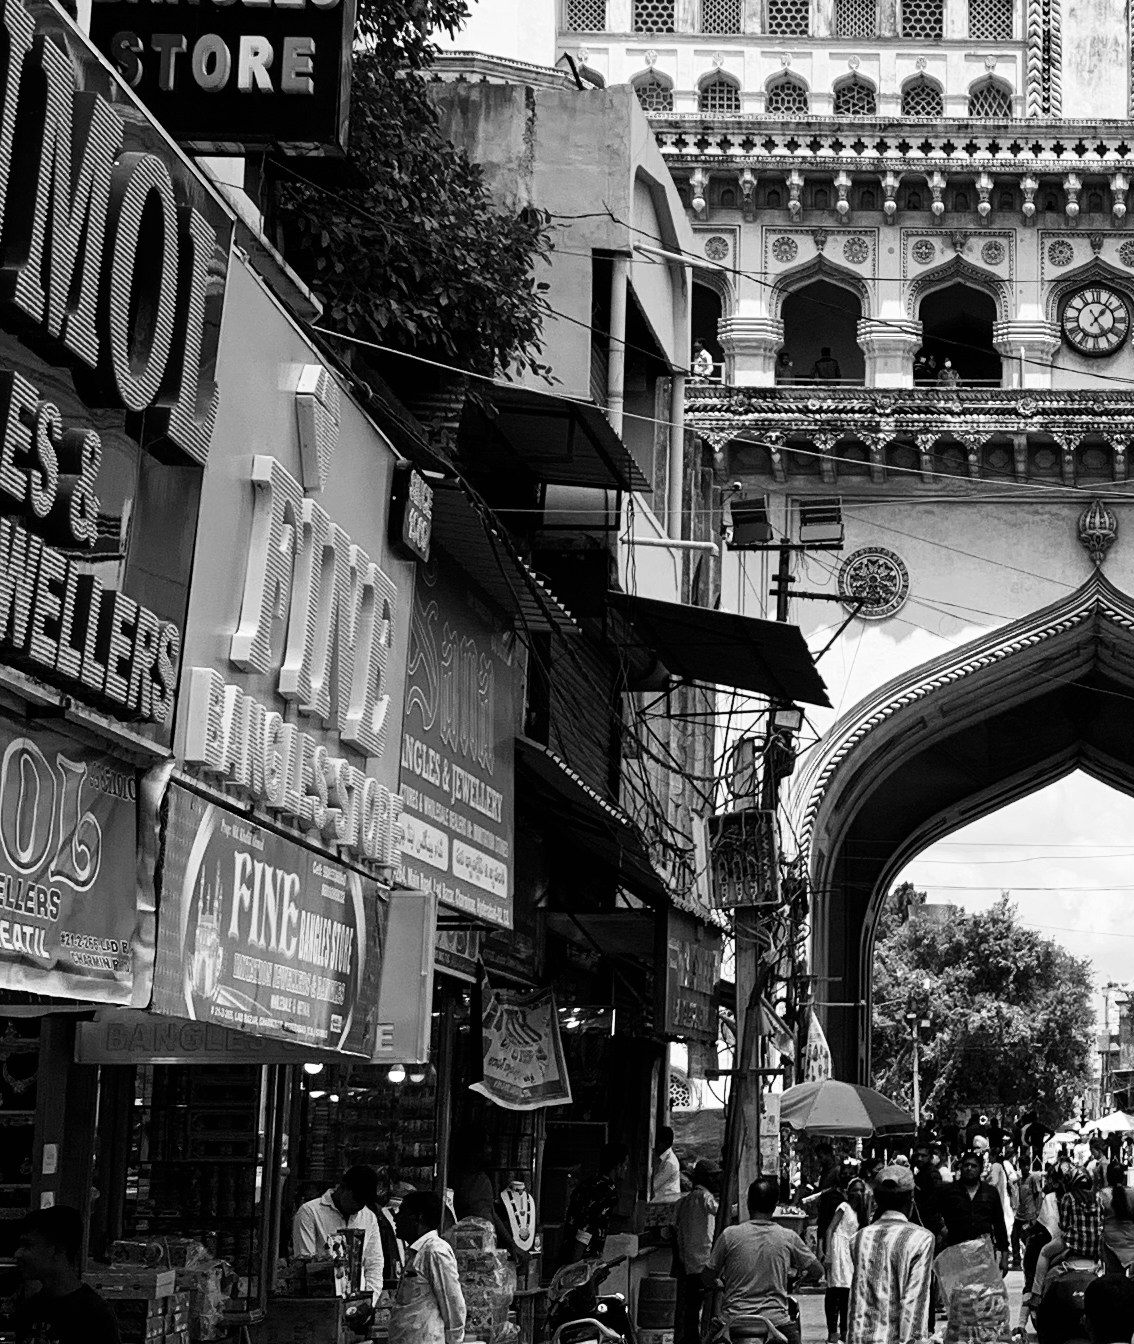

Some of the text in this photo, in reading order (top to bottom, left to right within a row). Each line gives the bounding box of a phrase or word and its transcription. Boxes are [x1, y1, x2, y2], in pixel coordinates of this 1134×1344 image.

[111, 31, 316, 96] STORE
[229, 454, 399, 758] FINE
[442, 757, 451, 794] &
[451, 762, 504, 824] JEWELLERY
[228, 850, 300, 961] FINE
